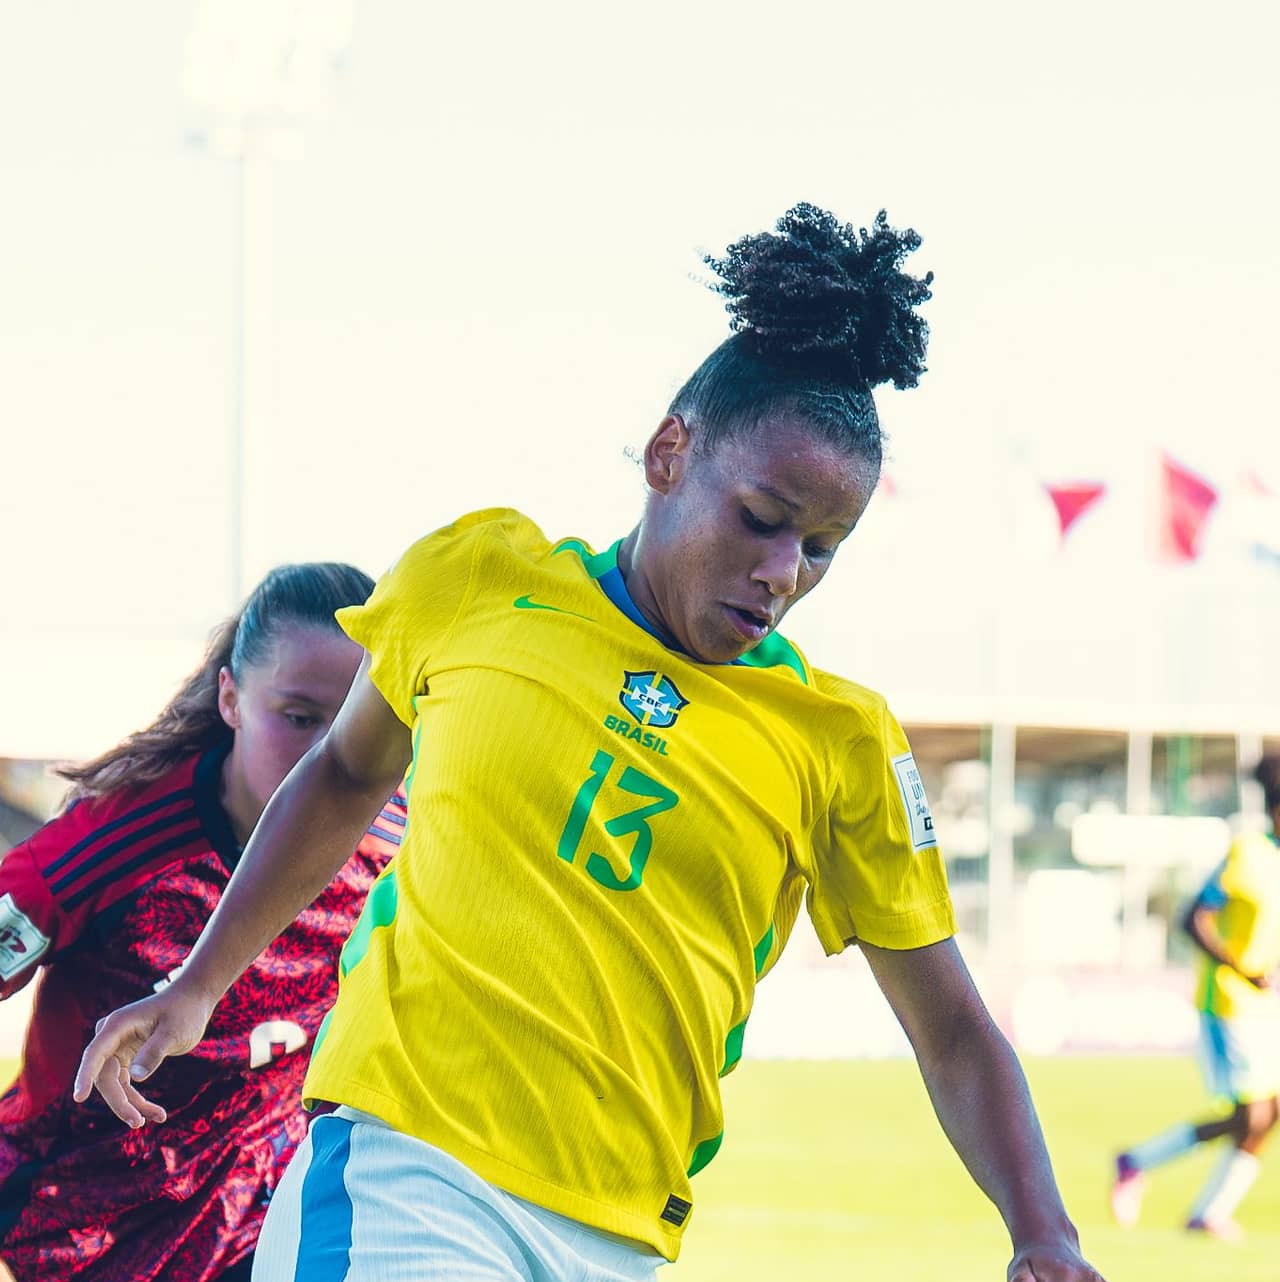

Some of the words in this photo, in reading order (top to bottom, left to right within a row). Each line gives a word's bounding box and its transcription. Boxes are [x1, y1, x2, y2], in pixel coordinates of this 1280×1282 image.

[638, 693, 663, 709] CBF
[603, 713, 669, 756] BRASIL
[557, 749, 680, 892] 13
